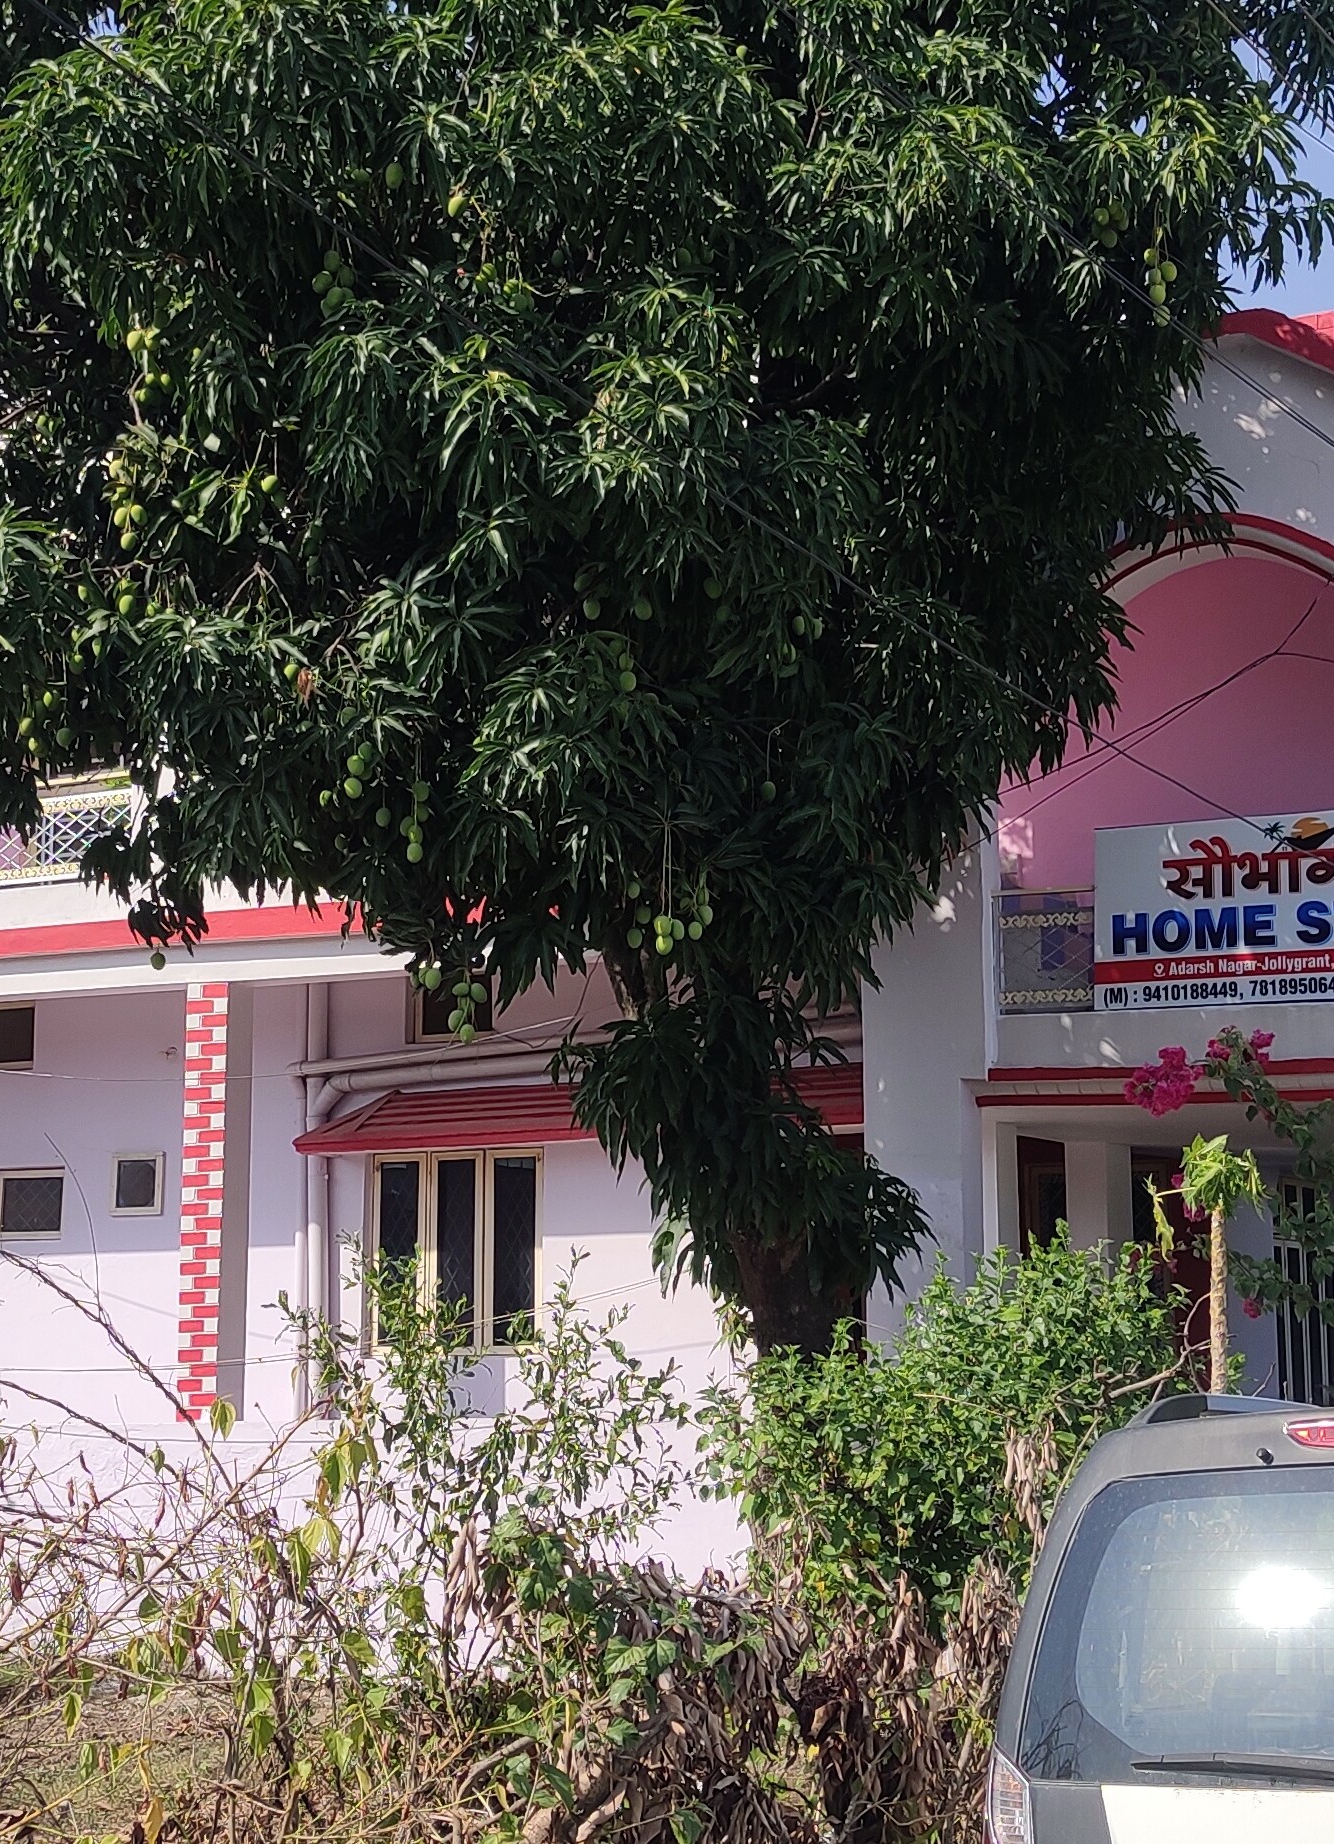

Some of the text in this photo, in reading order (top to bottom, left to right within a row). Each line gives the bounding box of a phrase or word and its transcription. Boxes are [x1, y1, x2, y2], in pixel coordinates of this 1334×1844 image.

[1111, 904, 1276, 956] HOME
[1169, 961, 1215, 976] Adarsh
[1103, 987, 1129, 1008] (M)
[1143, 981, 1244, 1001] 9410188449,
